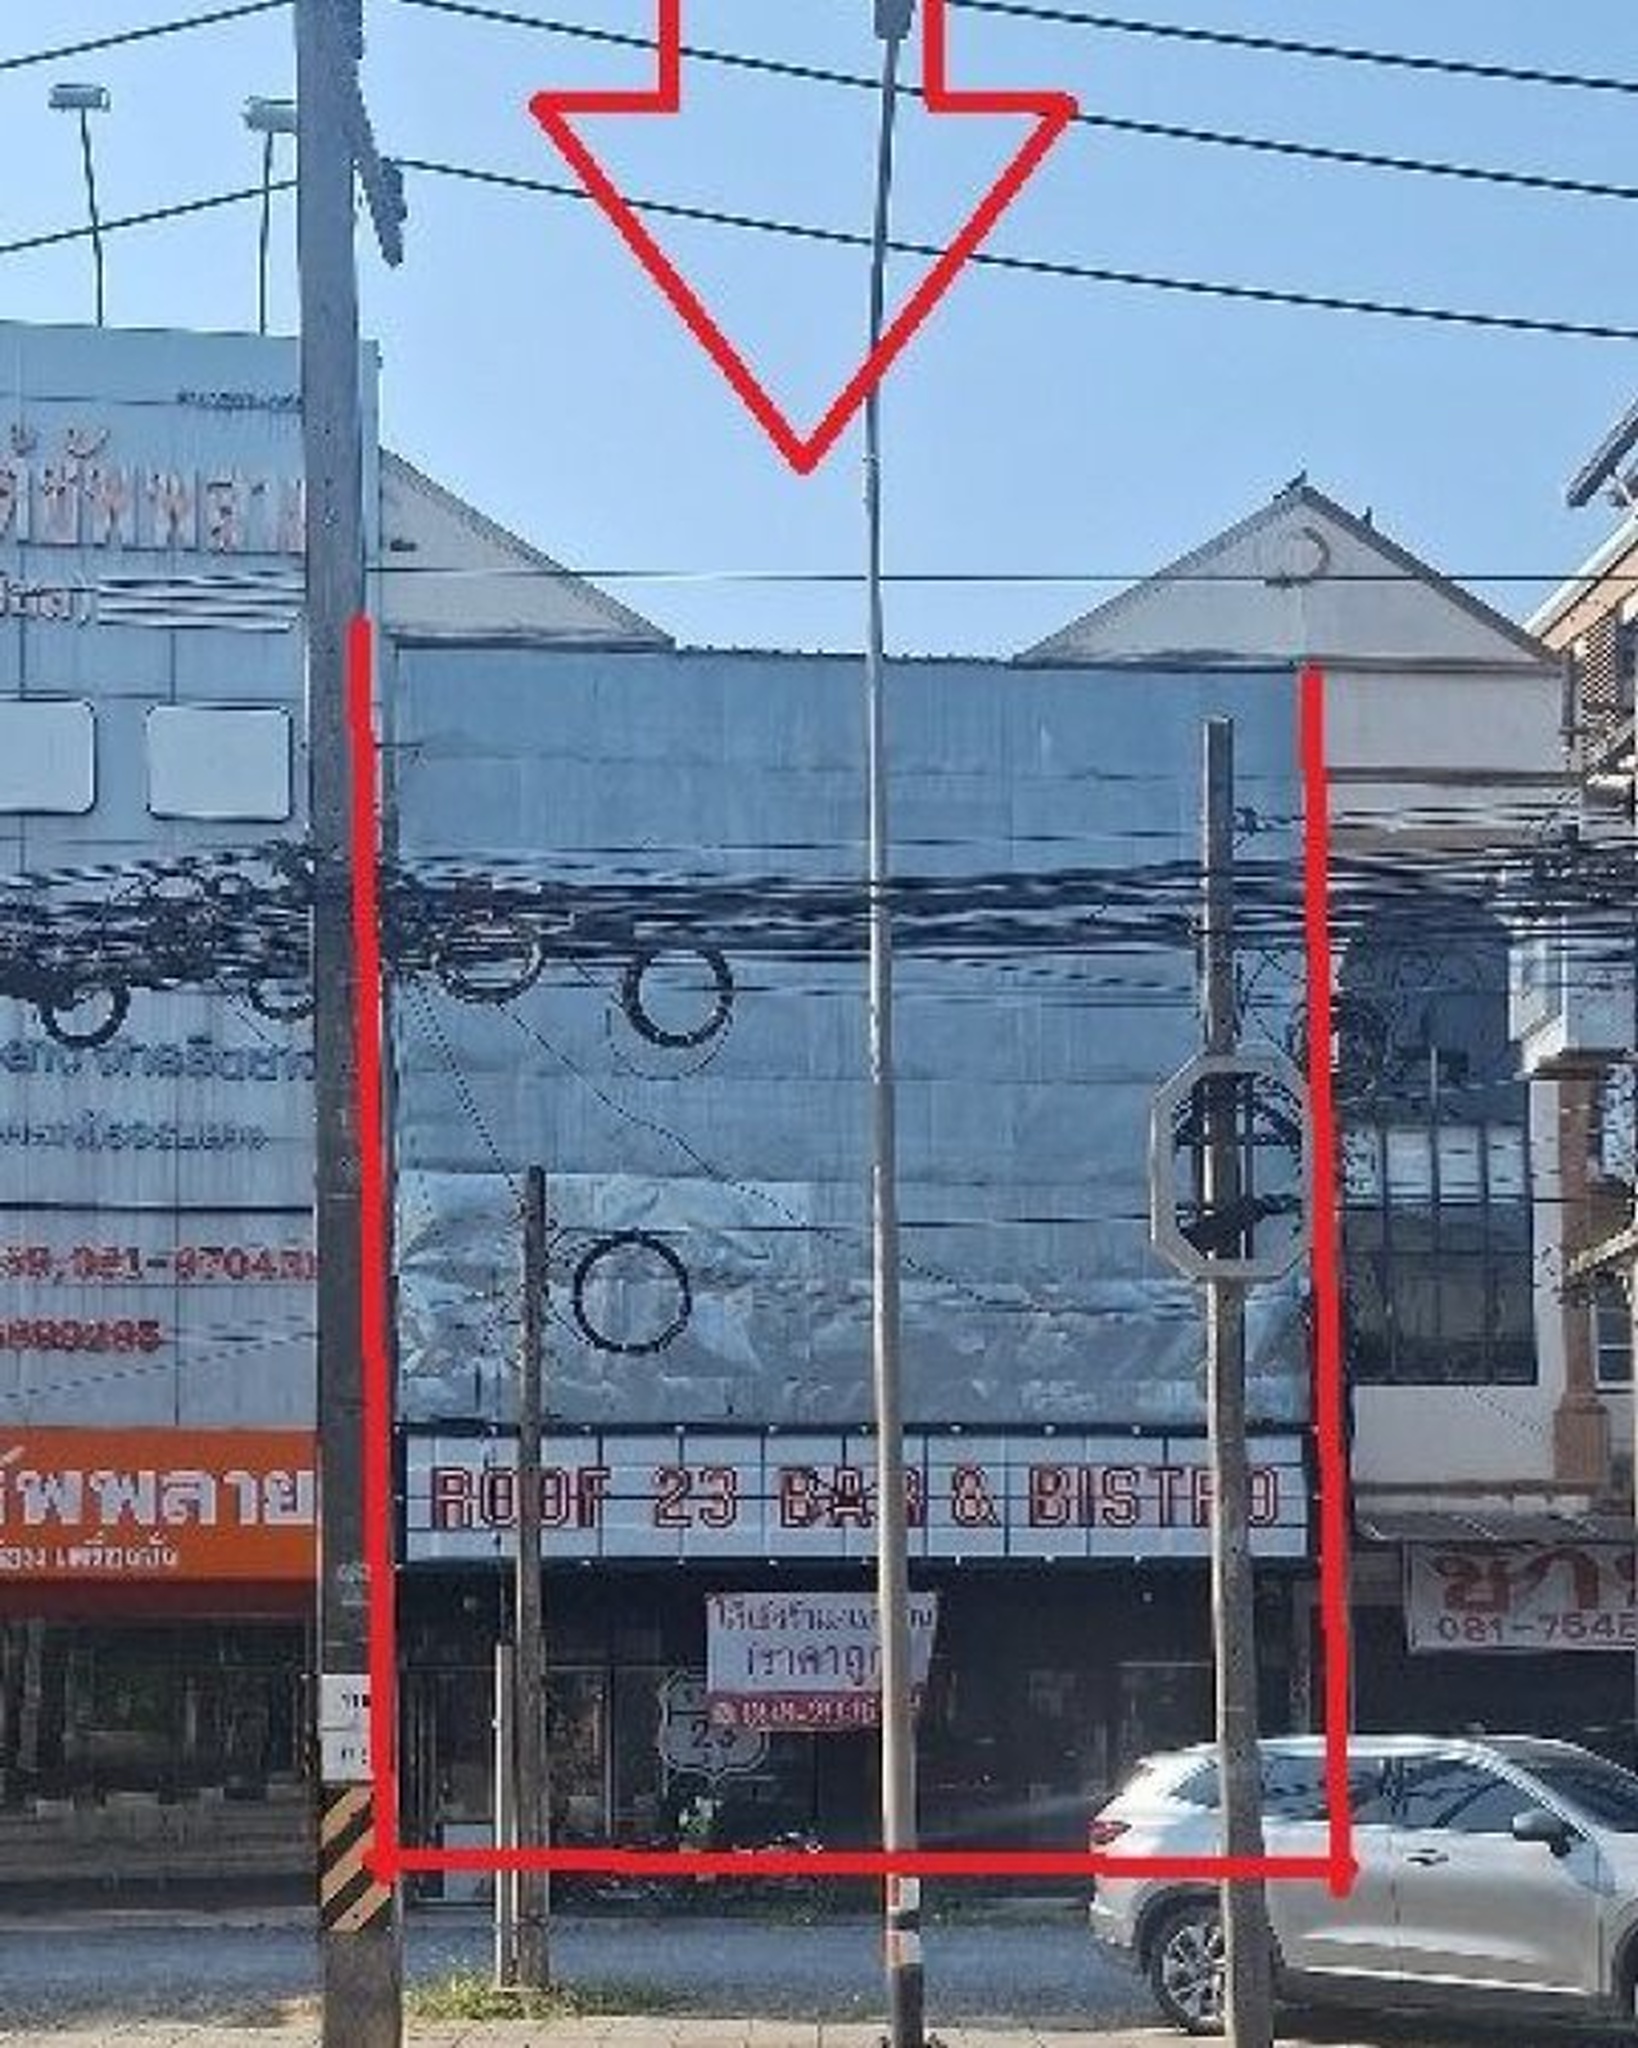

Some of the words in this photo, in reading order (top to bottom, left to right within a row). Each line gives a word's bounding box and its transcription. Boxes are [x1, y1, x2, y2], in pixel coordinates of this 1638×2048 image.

[430, 1466, 610, 1530] ROOF
[654, 1466, 737, 1529] 23
[952, 1465, 999, 1528] &
[1029, 1466, 1279, 1529] BISTRO
